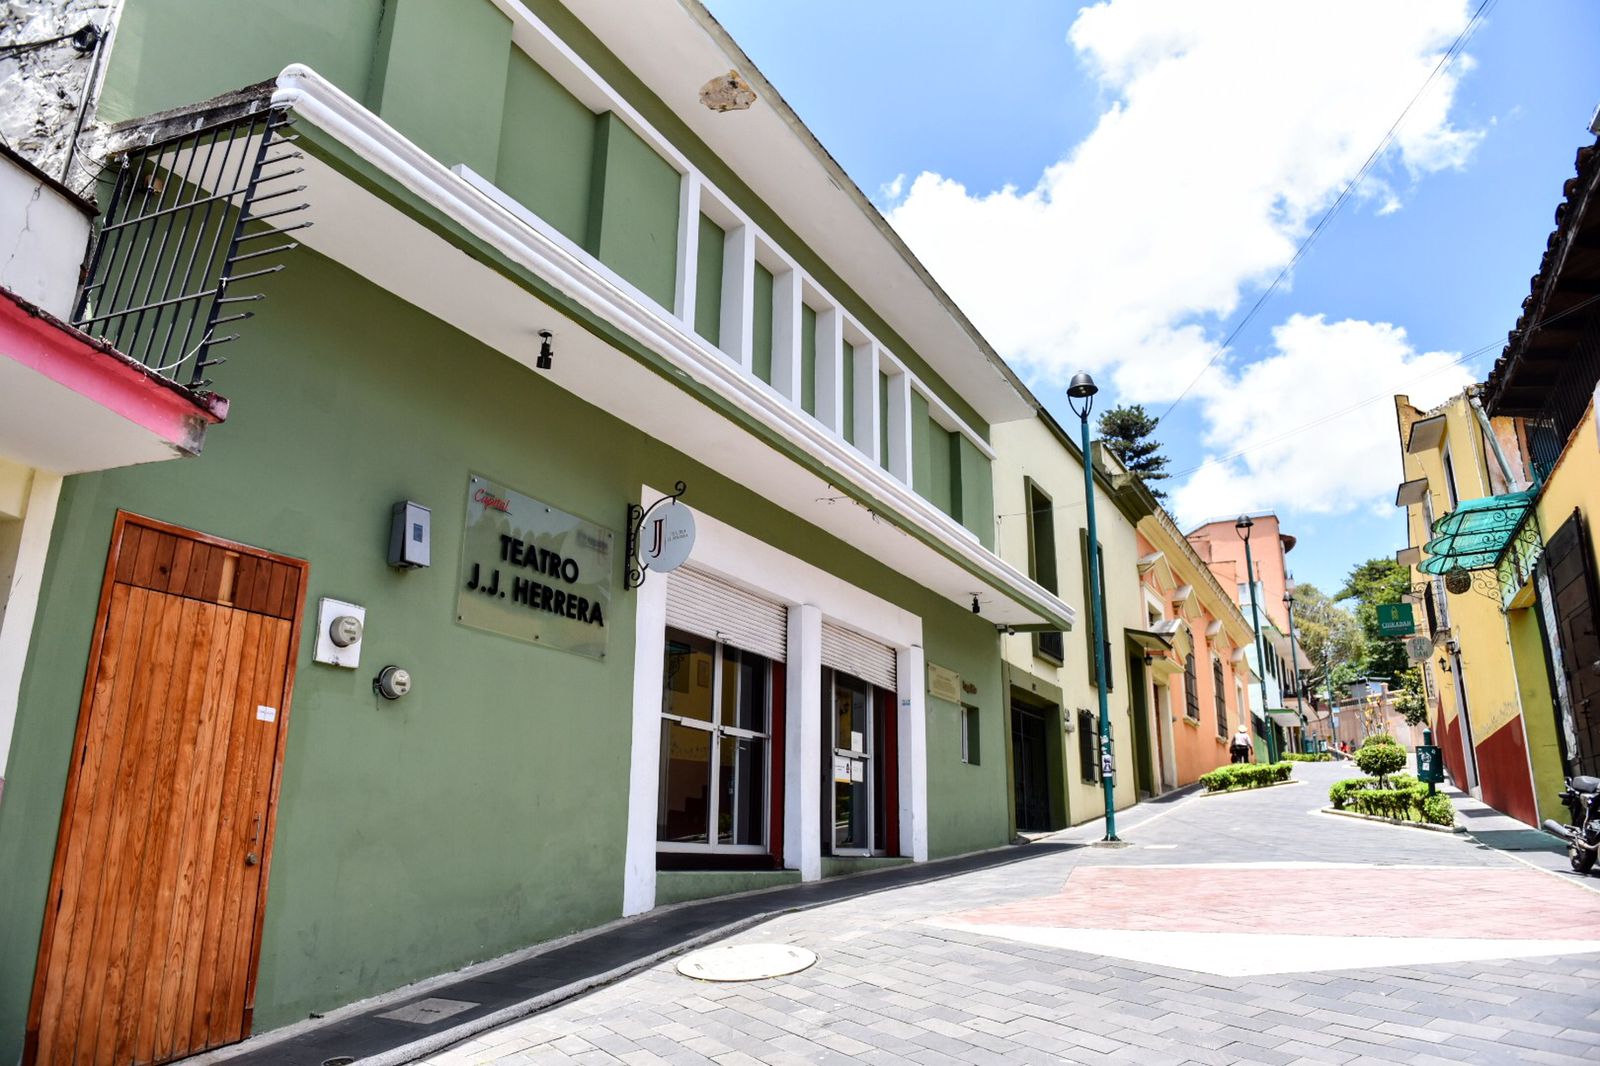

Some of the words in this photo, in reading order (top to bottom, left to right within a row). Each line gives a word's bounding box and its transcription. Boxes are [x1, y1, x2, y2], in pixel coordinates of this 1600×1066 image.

[474, 487, 511, 512] Capital
[500, 534, 579, 583] TEATRO
[467, 563, 505, 598] J.J.
[514, 576, 604, 627] HERRERA
